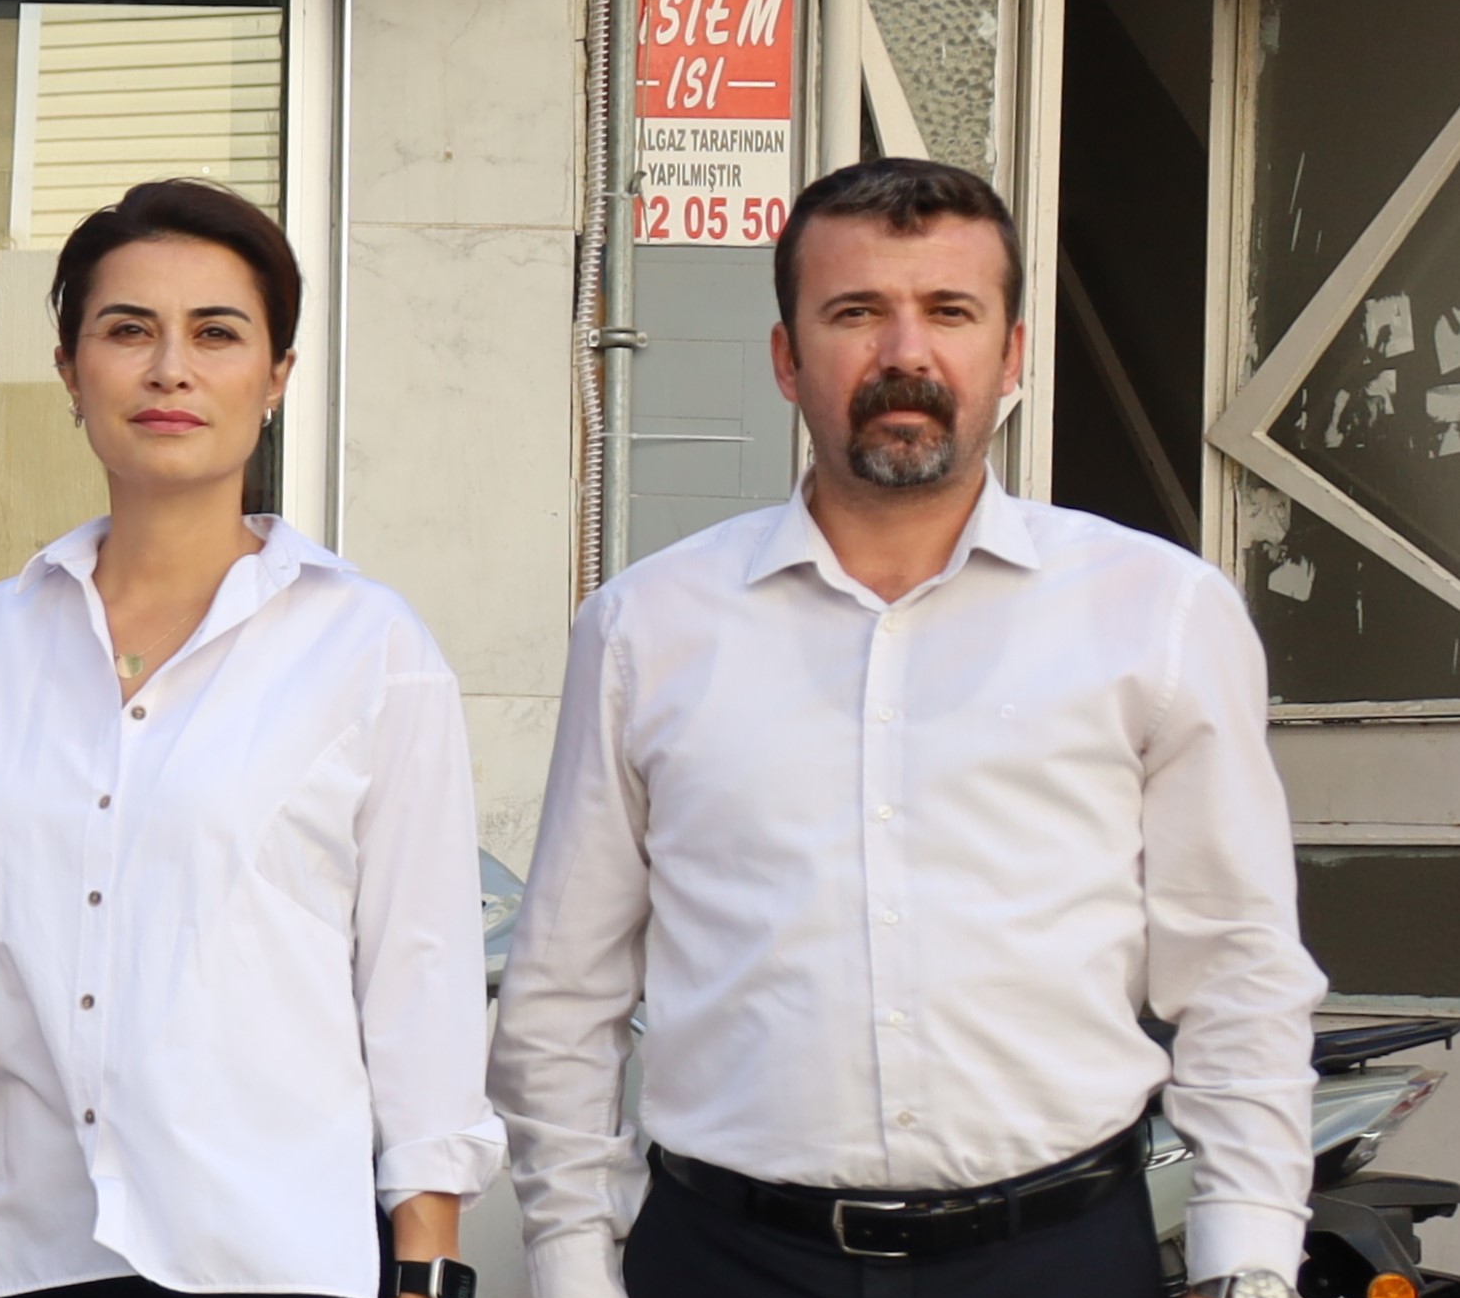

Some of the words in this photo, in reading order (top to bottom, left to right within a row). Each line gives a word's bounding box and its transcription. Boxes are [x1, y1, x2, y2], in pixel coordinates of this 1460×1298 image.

[666, 55, 725, 110] ISI
[691, 129, 785, 153] TARAFINDAN
[647, 162, 742, 193] YAPILMIŞTIR
[684, 195, 728, 240] 05
[741, 197, 787, 241] 50
